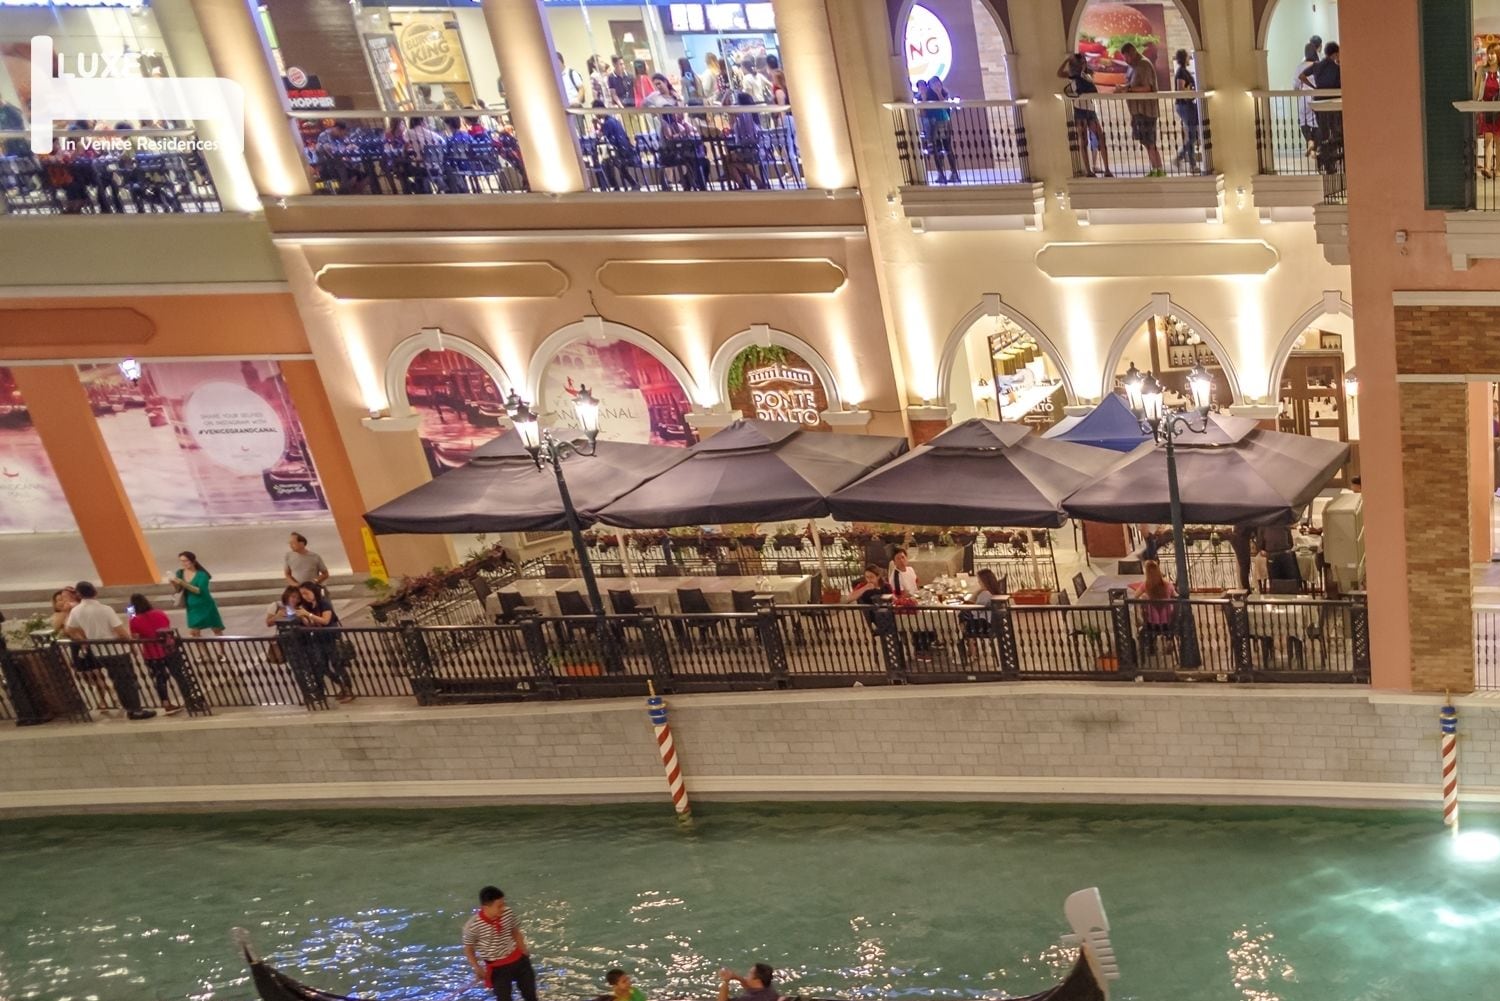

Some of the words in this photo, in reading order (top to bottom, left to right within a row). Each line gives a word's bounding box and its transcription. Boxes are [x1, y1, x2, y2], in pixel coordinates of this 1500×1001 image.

[411, 40, 451, 63] KING
[752, 390, 816, 409] PONTE
[199, 427, 278, 435] #VENICEGRANDCANAL
